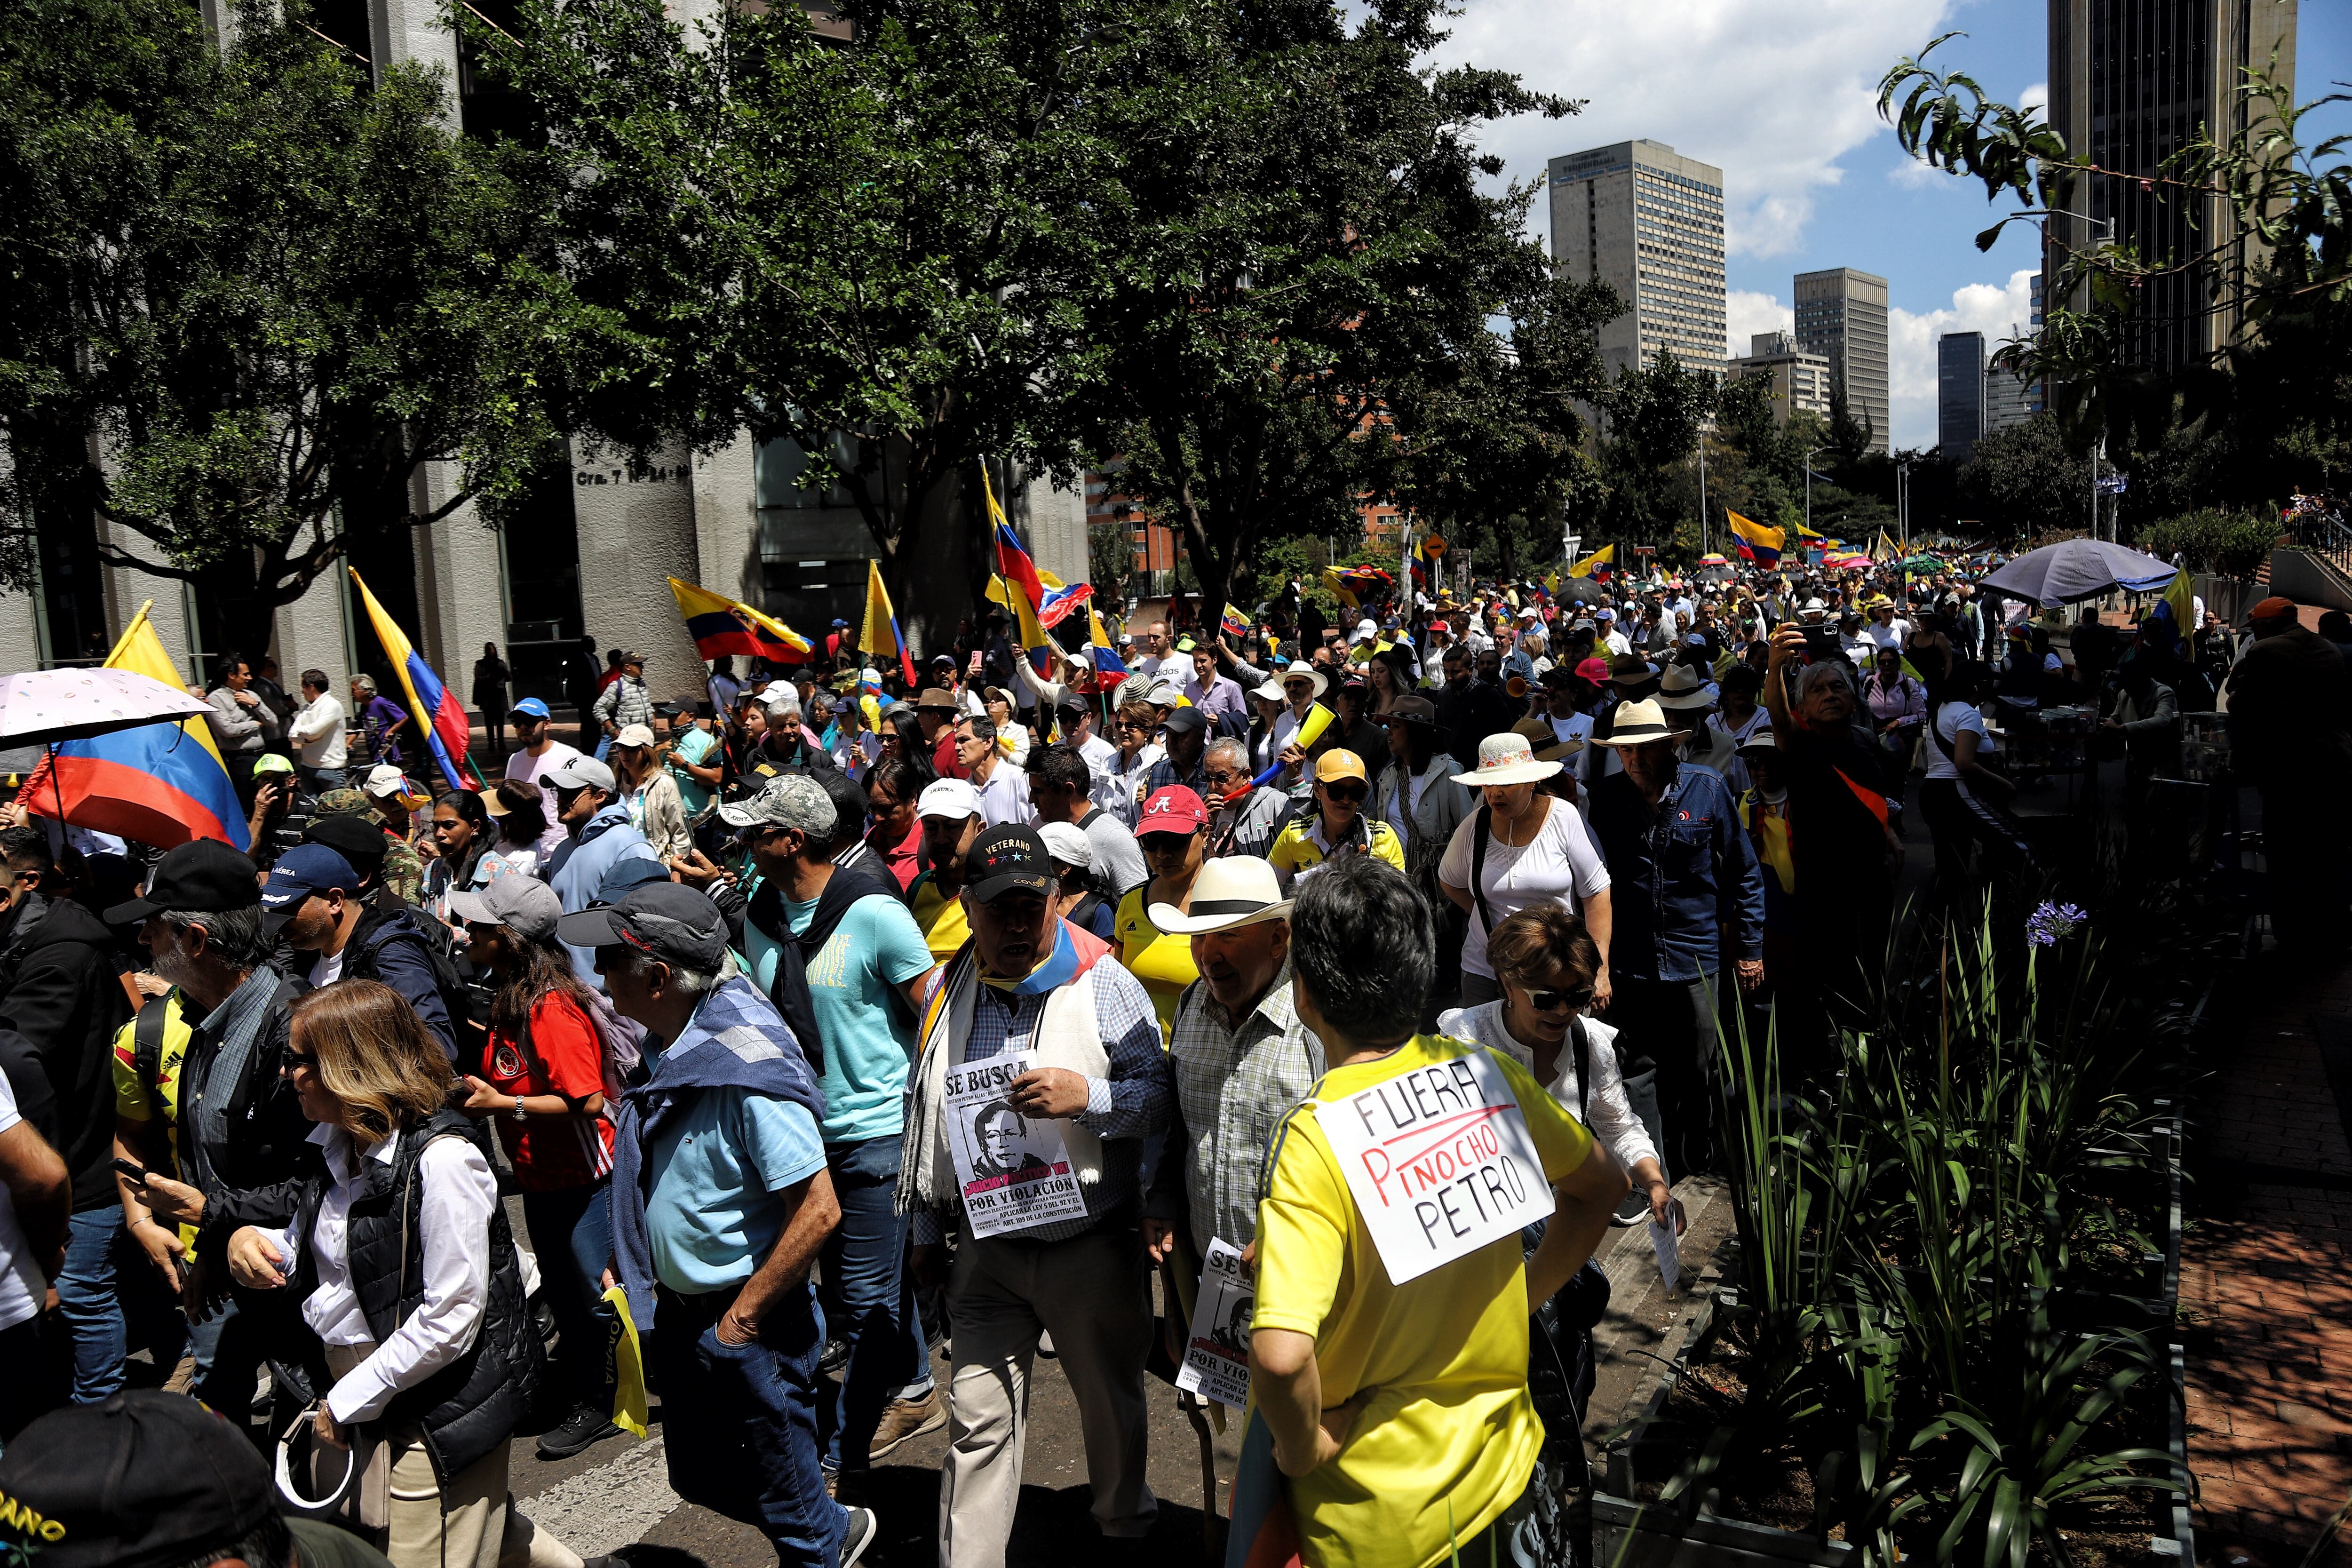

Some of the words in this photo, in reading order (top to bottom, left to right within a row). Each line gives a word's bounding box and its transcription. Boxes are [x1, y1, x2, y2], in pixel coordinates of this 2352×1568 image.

[577, 472, 607, 485] Cra.
[612, 470, 621, 484] 7
[2095, 476, 2127, 489] SOAT
[1150, 668, 1179, 677] adidas
[1341, 752, 1352, 765] LA
[1148, 796, 1171, 814] A
[985, 838, 1031, 855] VETERANO
[274, 866, 295, 876] AÉREA
[946, 1074, 964, 1096] SE
[966, 1060, 1030, 1092] BUSCA
[985, 1087, 1009, 1097] "AURELIAN
[1352, 1060, 1486, 1137] FUERA
[1051, 1161, 1070, 1175] YA!
[1361, 1124, 1498, 1207] PINOCHO
[967, 1195, 997, 1211] POR
[998, 1176, 1075, 1204] VIOLACIÓN
[1029, 1196, 1049, 1205] CAMPAÑA
[1049, 1191, 1077, 1201] PRESIDENCIAL
[1414, 1155, 1526, 1250] PETRO
[1000, 1207, 1024, 1219] APLICAR
[1002, 1218, 1015, 1227] ART.
[1042, 1205, 1082, 1218] CONSTITUCIÓN
[976, 1222, 1000, 1231] CONGRESO
[1210, 1250, 1239, 1275] SE
[1208, 1268, 1230, 1279] GUSTAVO
[1188, 1349, 1218, 1371] POR
[1209, 1386, 1222, 1396] ART.
[1212, 1378, 1237, 1393] APLICAR
[0, 1489, 66, 1542] ANO
